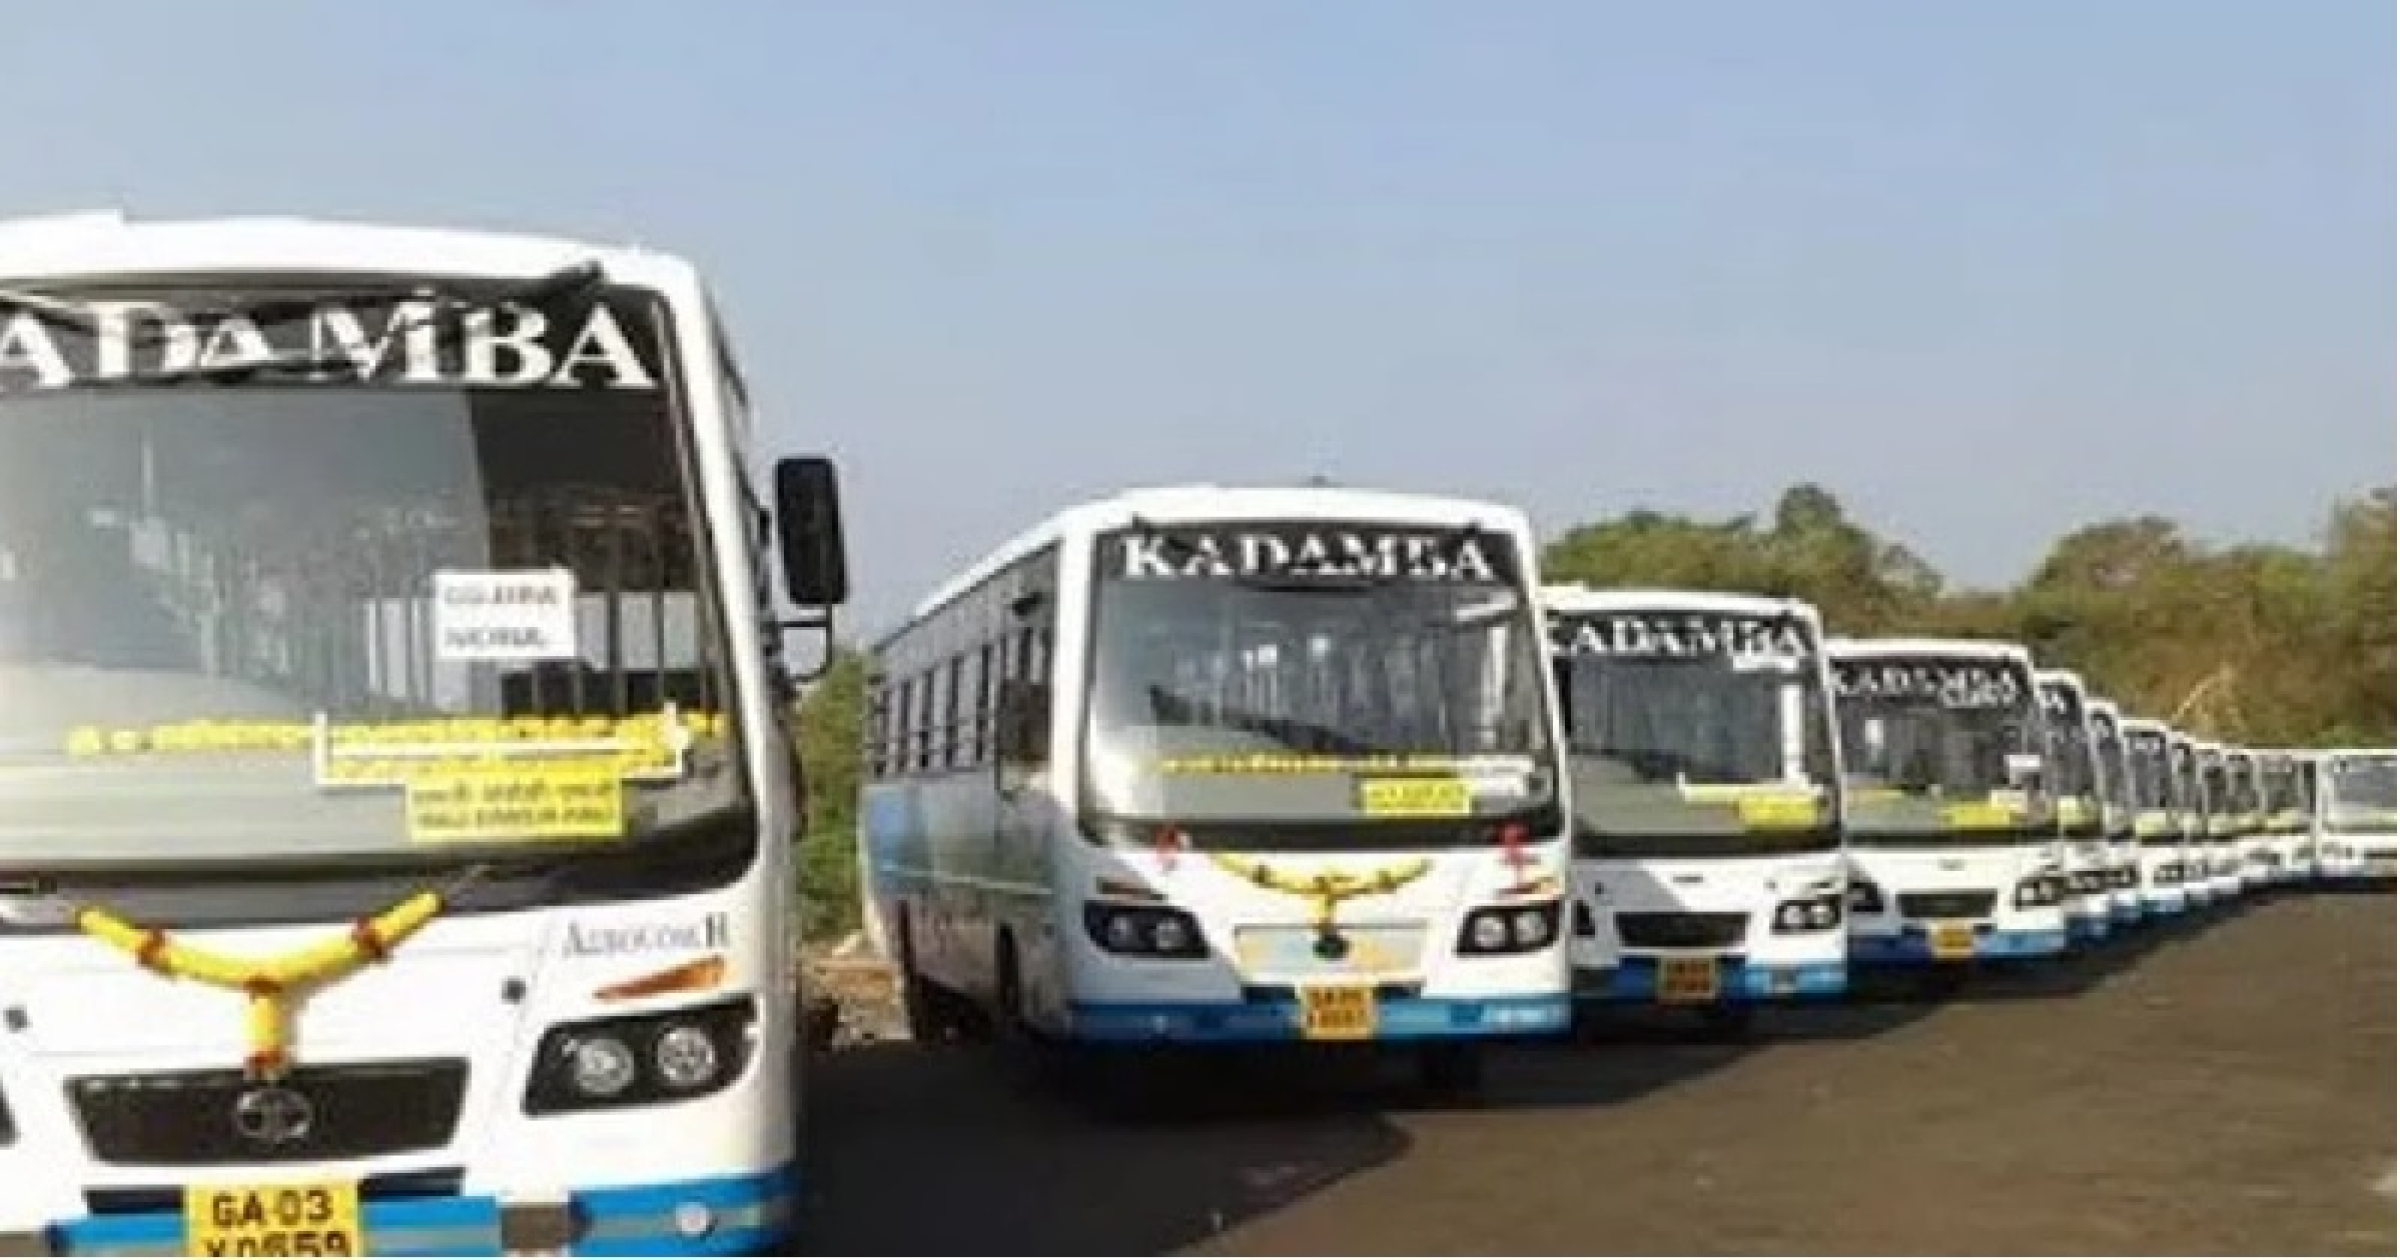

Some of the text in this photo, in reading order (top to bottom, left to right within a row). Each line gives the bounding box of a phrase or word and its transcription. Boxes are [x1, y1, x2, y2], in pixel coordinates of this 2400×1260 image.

[1121, 533, 1496, 580] KADAMBA
[212, 1189, 334, 1229] GA 03
